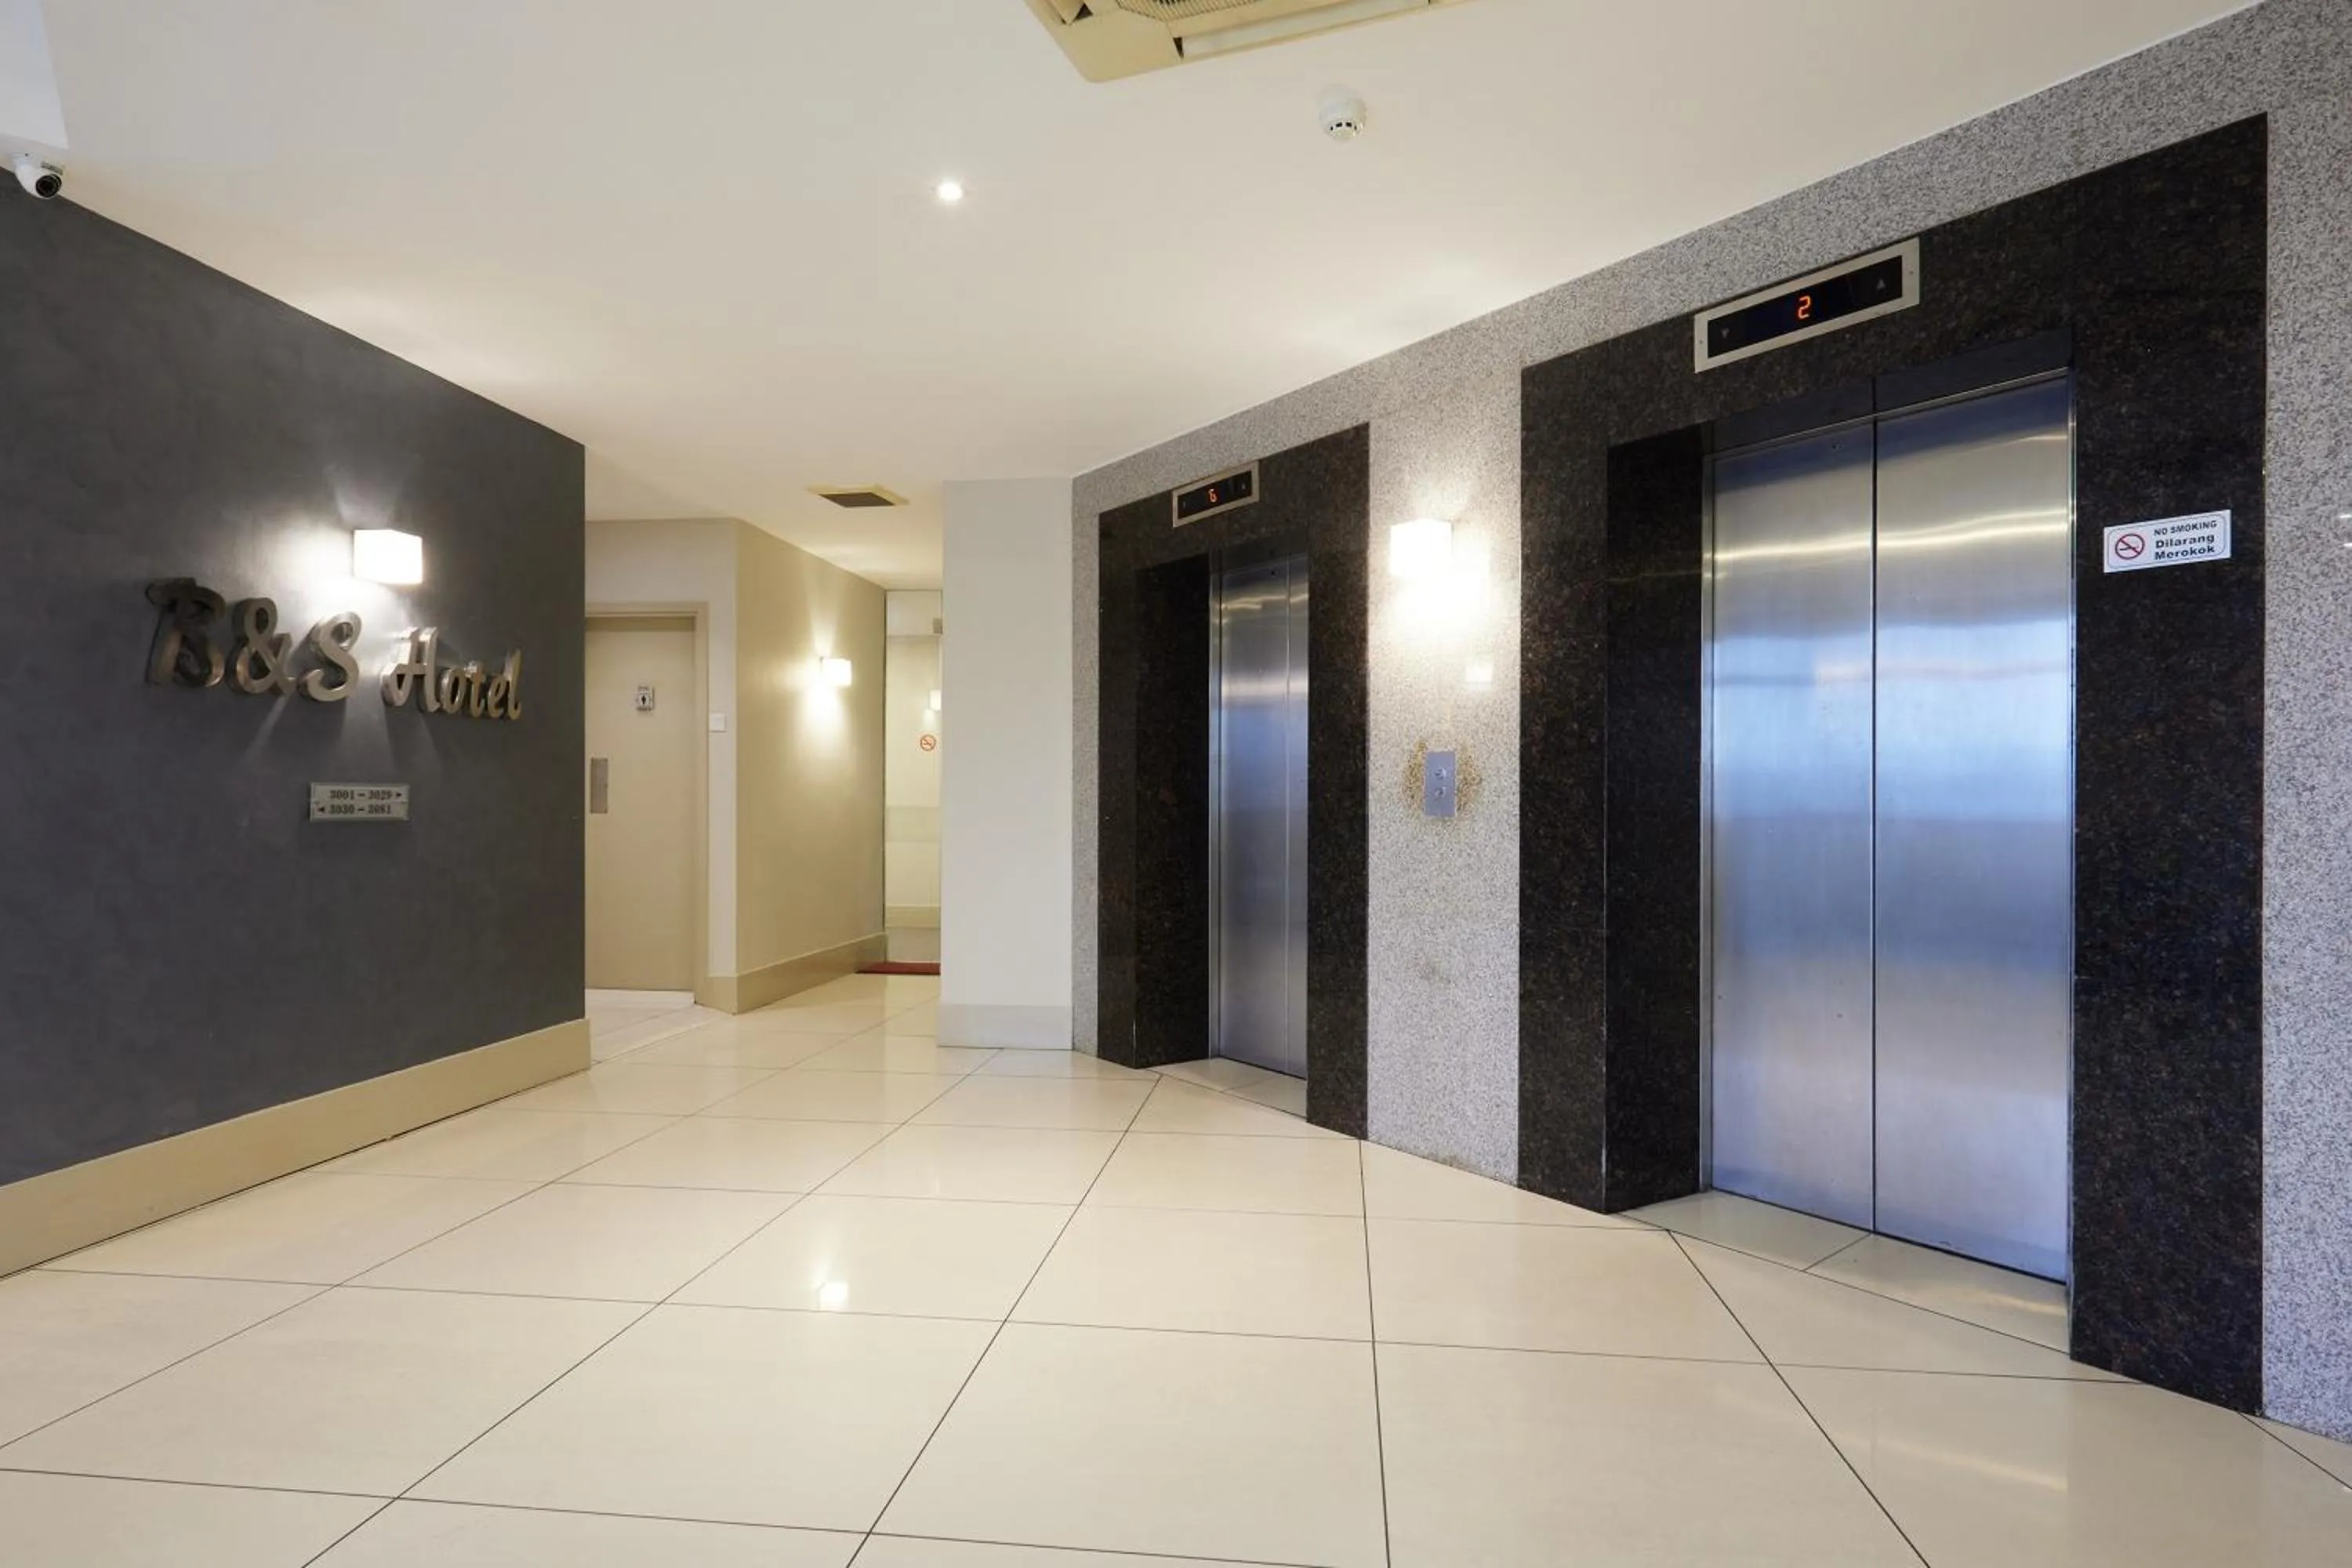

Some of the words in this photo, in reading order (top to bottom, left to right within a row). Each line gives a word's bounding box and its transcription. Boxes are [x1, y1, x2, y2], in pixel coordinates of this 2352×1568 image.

[1798, 295, 1811, 319] 2
[1208, 488, 1218, 503] 6
[2154, 527, 2168, 536] NO
[2170, 520, 2218, 534] SMOKING
[2155, 534, 2215, 549] Dilarang
[2154, 545, 2215, 561] Merokok
[380, 626, 523, 721] Hotel
